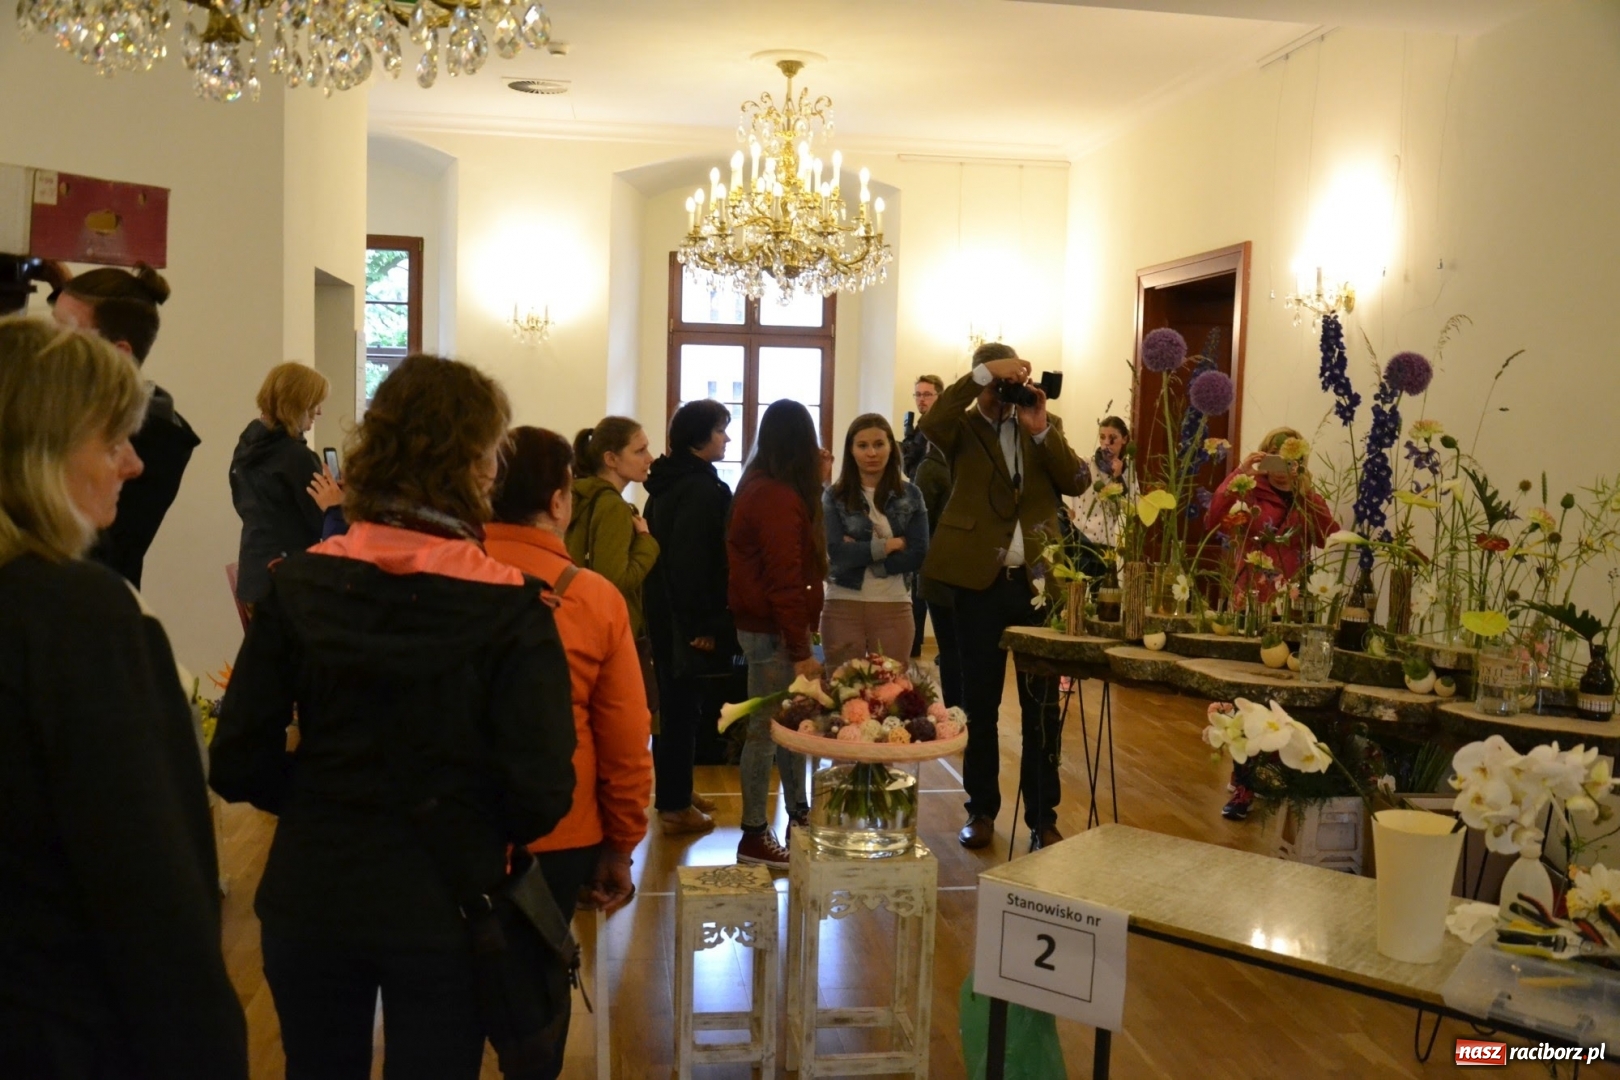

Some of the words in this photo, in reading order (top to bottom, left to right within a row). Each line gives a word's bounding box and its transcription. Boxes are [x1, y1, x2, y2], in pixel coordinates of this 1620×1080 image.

[1006, 893, 1082, 922] Stanowisko
[1086, 914, 1101, 927] nr
[1034, 933, 1056, 971] 2
